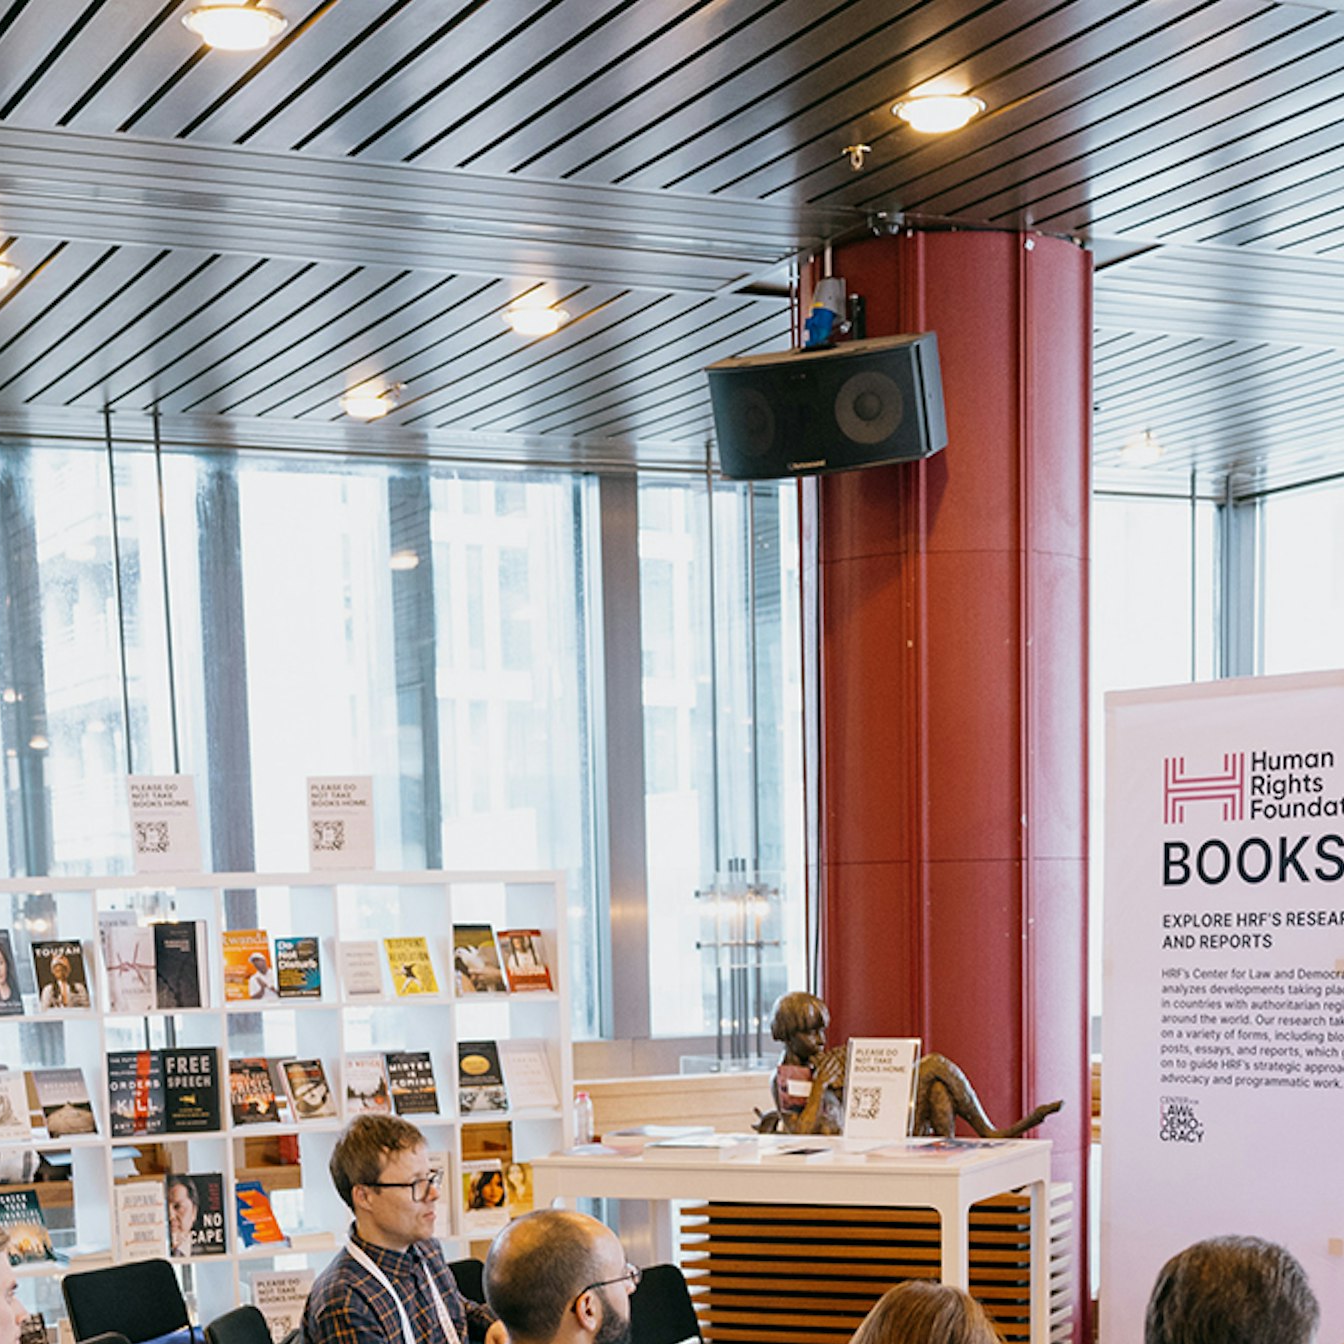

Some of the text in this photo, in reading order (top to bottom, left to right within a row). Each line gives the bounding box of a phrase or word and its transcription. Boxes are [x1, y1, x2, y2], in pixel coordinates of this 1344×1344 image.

[1251, 751, 1334, 772] Human
[1250, 775, 1324, 796] Rights
[1162, 912, 1232, 928] EXPLORE
[1236, 912, 1281, 927] HRF'S
[1162, 933, 1272, 949] AND REPORTS
[1161, 967, 1190, 979] HRF's
[1192, 967, 1228, 979] Center
[1230, 967, 1246, 979] for
[1248, 968, 1271, 980] Law
[1273, 968, 1295, 979] and
[1161, 983, 1206, 996] analyzes
[1209, 983, 1285, 996] developments
[1287, 983, 1322, 998] taking
[1161, 998, 1170, 1008] in
[1172, 998, 1222, 1009] countries
[1224, 998, 1248, 1010] with
[1250, 999, 1321, 1010] authoritarian
[1161, 1013, 1197, 1024] around
[1199, 1013, 1217, 1024] the
[1220, 1014, 1252, 1025] world.
[1254, 1013, 1275, 1026] Our
[1277, 1015, 1326, 1026] research
[1160, 1029, 1174, 1038] on
[1176, 1029, 1183, 1038] a
[1185, 1028, 1222, 1042] variety
[1223, 1028, 1235, 1040] of
[1237, 1028, 1271, 1042] forms,
[1274, 1029, 1325, 1045] including
[1160, 1043, 1192, 1055] posts,
[1194, 1045, 1234, 1057] essays,
[1236, 1044, 1257, 1056] and
[1259, 1045, 1303, 1058] reports,
[1304, 1045, 1339, 1058] which
[166, 1056, 210, 1074] FREE
[1159, 1059, 1174, 1068] on
[1175, 1058, 1187, 1068] to
[1189, 1058, 1218, 1072] guide
[1220, 1058, 1250, 1070] HRF's
[1253, 1060, 1301, 1074] strategic
[110, 1080, 160, 1092] ORDERS
[167, 1076, 212, 1088] SPEECH
[1160, 1072, 1343, 1089] advocacy and programmatic work.
[116, 1098, 156, 1112] KILL
[1159, 1130, 1205, 1142] CRACY
[202, 1212, 222, 1227] NO
